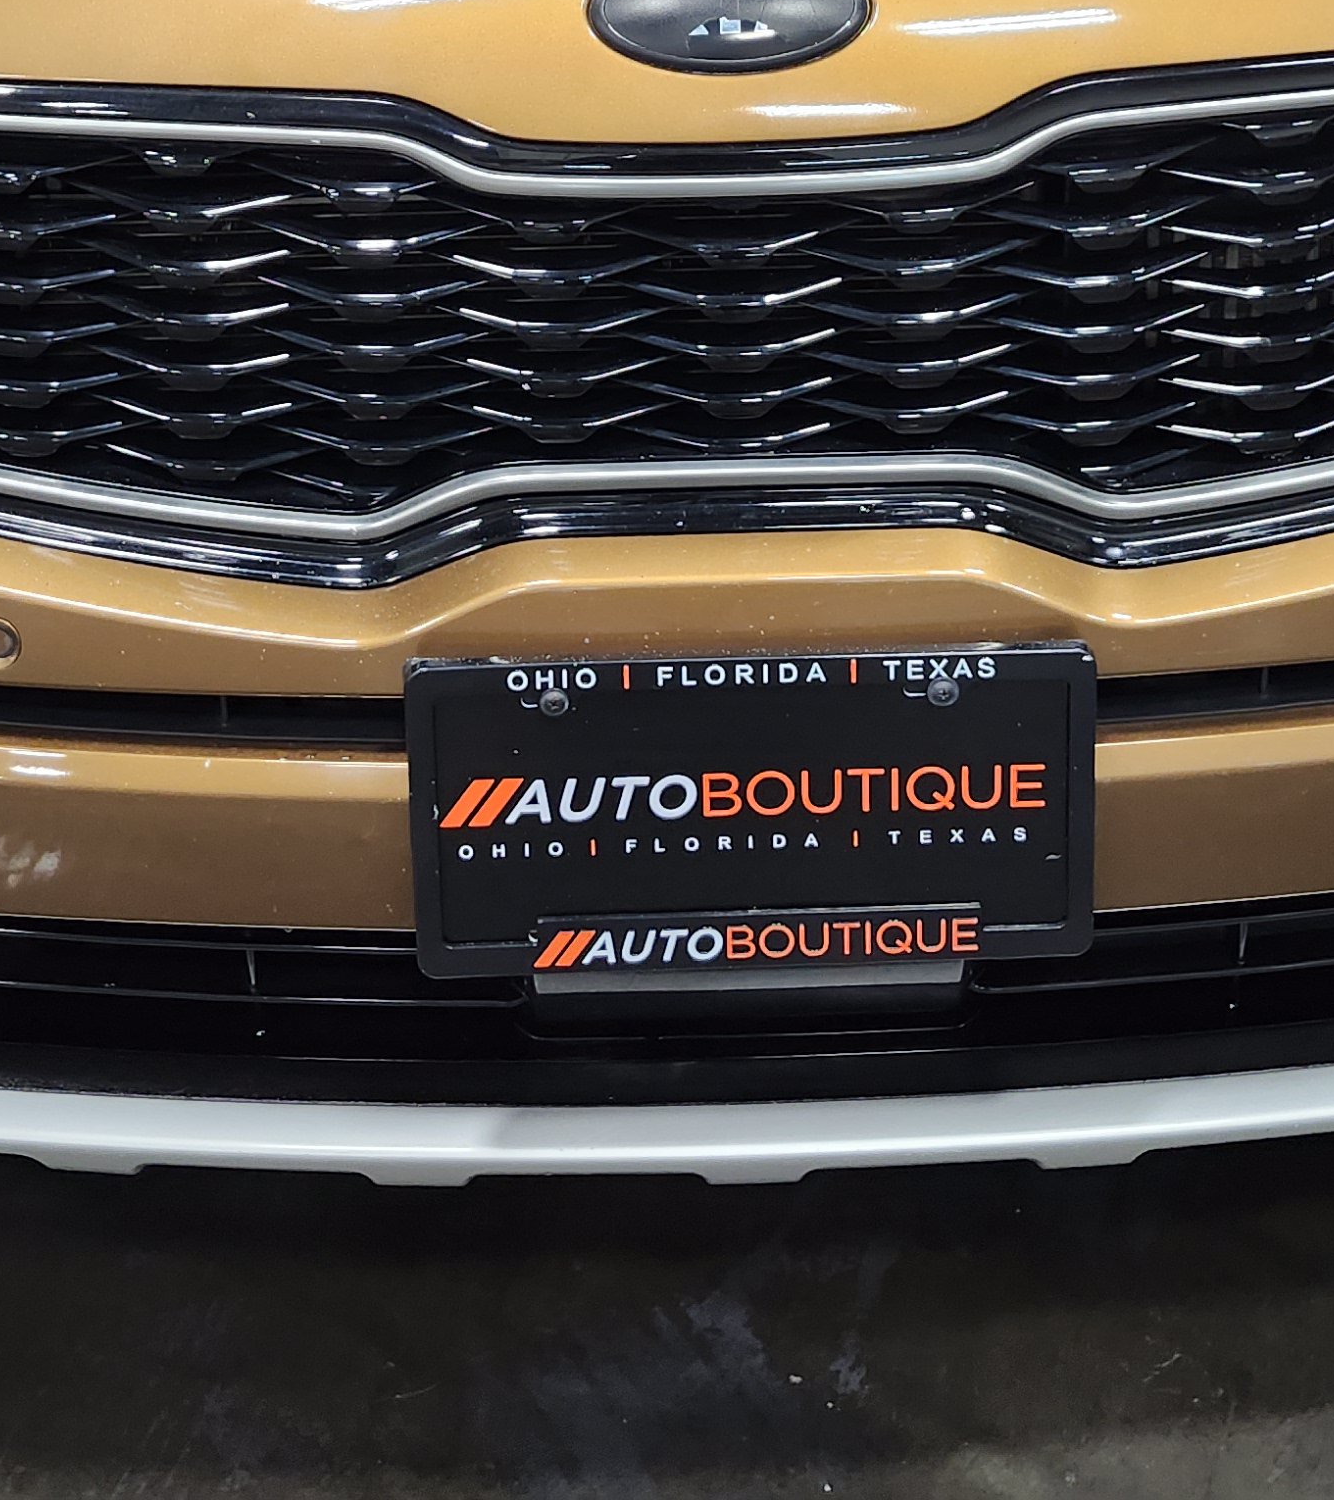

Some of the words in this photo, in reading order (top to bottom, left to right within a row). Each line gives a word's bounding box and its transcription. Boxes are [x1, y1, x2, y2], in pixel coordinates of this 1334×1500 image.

[506, 668, 597, 691] OHIO
[656, 662, 829, 686] FLORIDA
[883, 656, 997, 681] TEXAS
[503, 763, 1047, 826] AUTOBOUTIQUE
[458, 841, 564, 861] OHIO
[624, 832, 819, 854] FLORIDA
[888, 826, 1028, 845] TEXAS
[581, 917, 979, 965] AUTOBOUTIQUE
